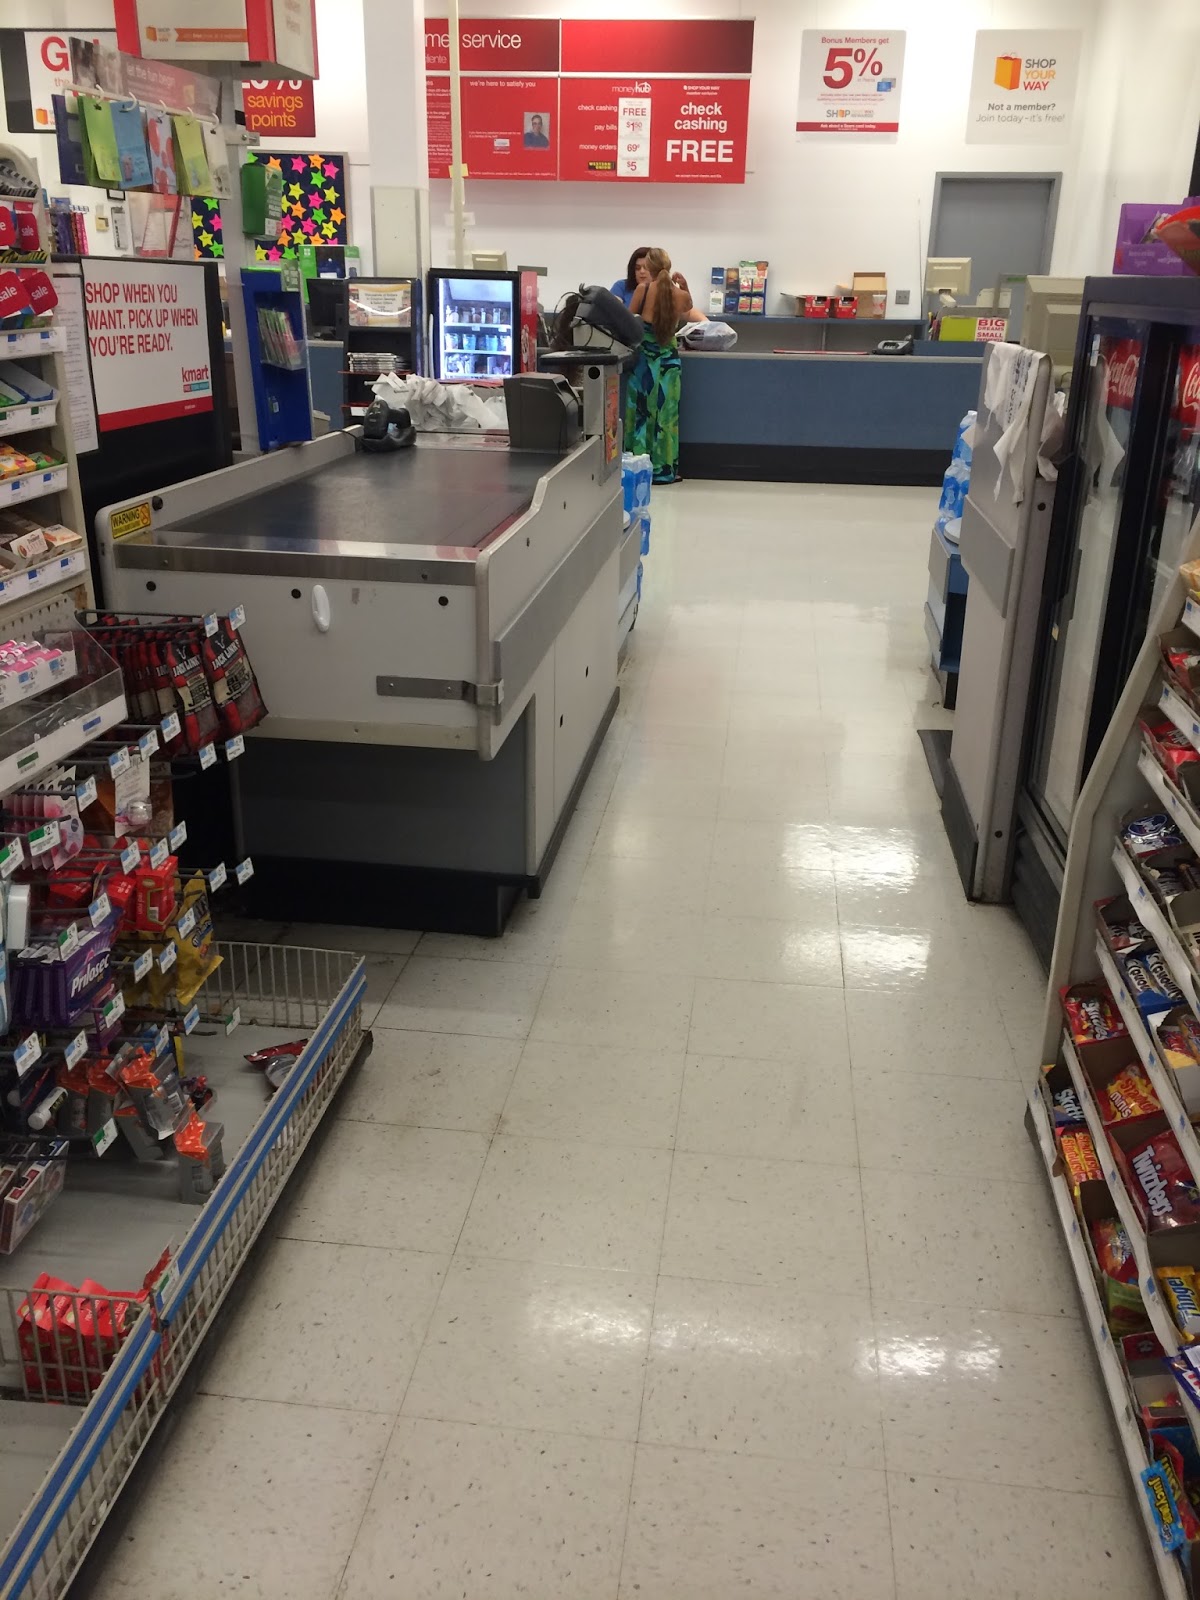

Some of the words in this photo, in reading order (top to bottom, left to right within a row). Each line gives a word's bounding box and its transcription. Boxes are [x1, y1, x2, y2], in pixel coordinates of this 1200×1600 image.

[462, 30, 522, 49] service
[823, 48, 883, 89] 5%
[1025, 58, 1057, 69] SHOP
[1025, 70, 1056, 80] YOUR
[1023, 81, 1050, 91] WAY
[247, 93, 304, 112] savings
[596, 104, 618, 112] cashing
[623, 107, 647, 117] FREE
[680, 102, 723, 115] check
[988, 103, 1004, 111] Not
[1013, 103, 1056, 111] member?
[252, 112, 297, 130] points
[674, 117, 728, 133] cashing
[976, 114, 995, 122] Join
[666, 140, 734, 163] FREE
[31, 286, 49, 300] sale
[85, 282, 120, 304] SHOP
[122, 283, 155, 303] WHEN
[157, 284, 178, 303] YOU
[86, 309, 126, 330] WANT.
[128, 309, 154, 329] PICK
[155, 308, 169, 328] UP
[171, 308, 199, 327] WHEN
[978, 319, 1005, 327] BIG
[89, 334, 135, 357] YOU'RE
[137, 333, 173, 353] READY.
[181, 364, 209, 383] kmart
[112, 508, 140, 528] WARNING
[212, 653, 228, 671] JACK
[70, 953, 110, 999] Prilosec
[1110, 1091, 1133, 1119] minis
[1132, 1145, 1173, 1216] Twizzlers
[1166, 1276, 1199, 1311] finger
[1148, 1476, 1168, 1508] JUICY
